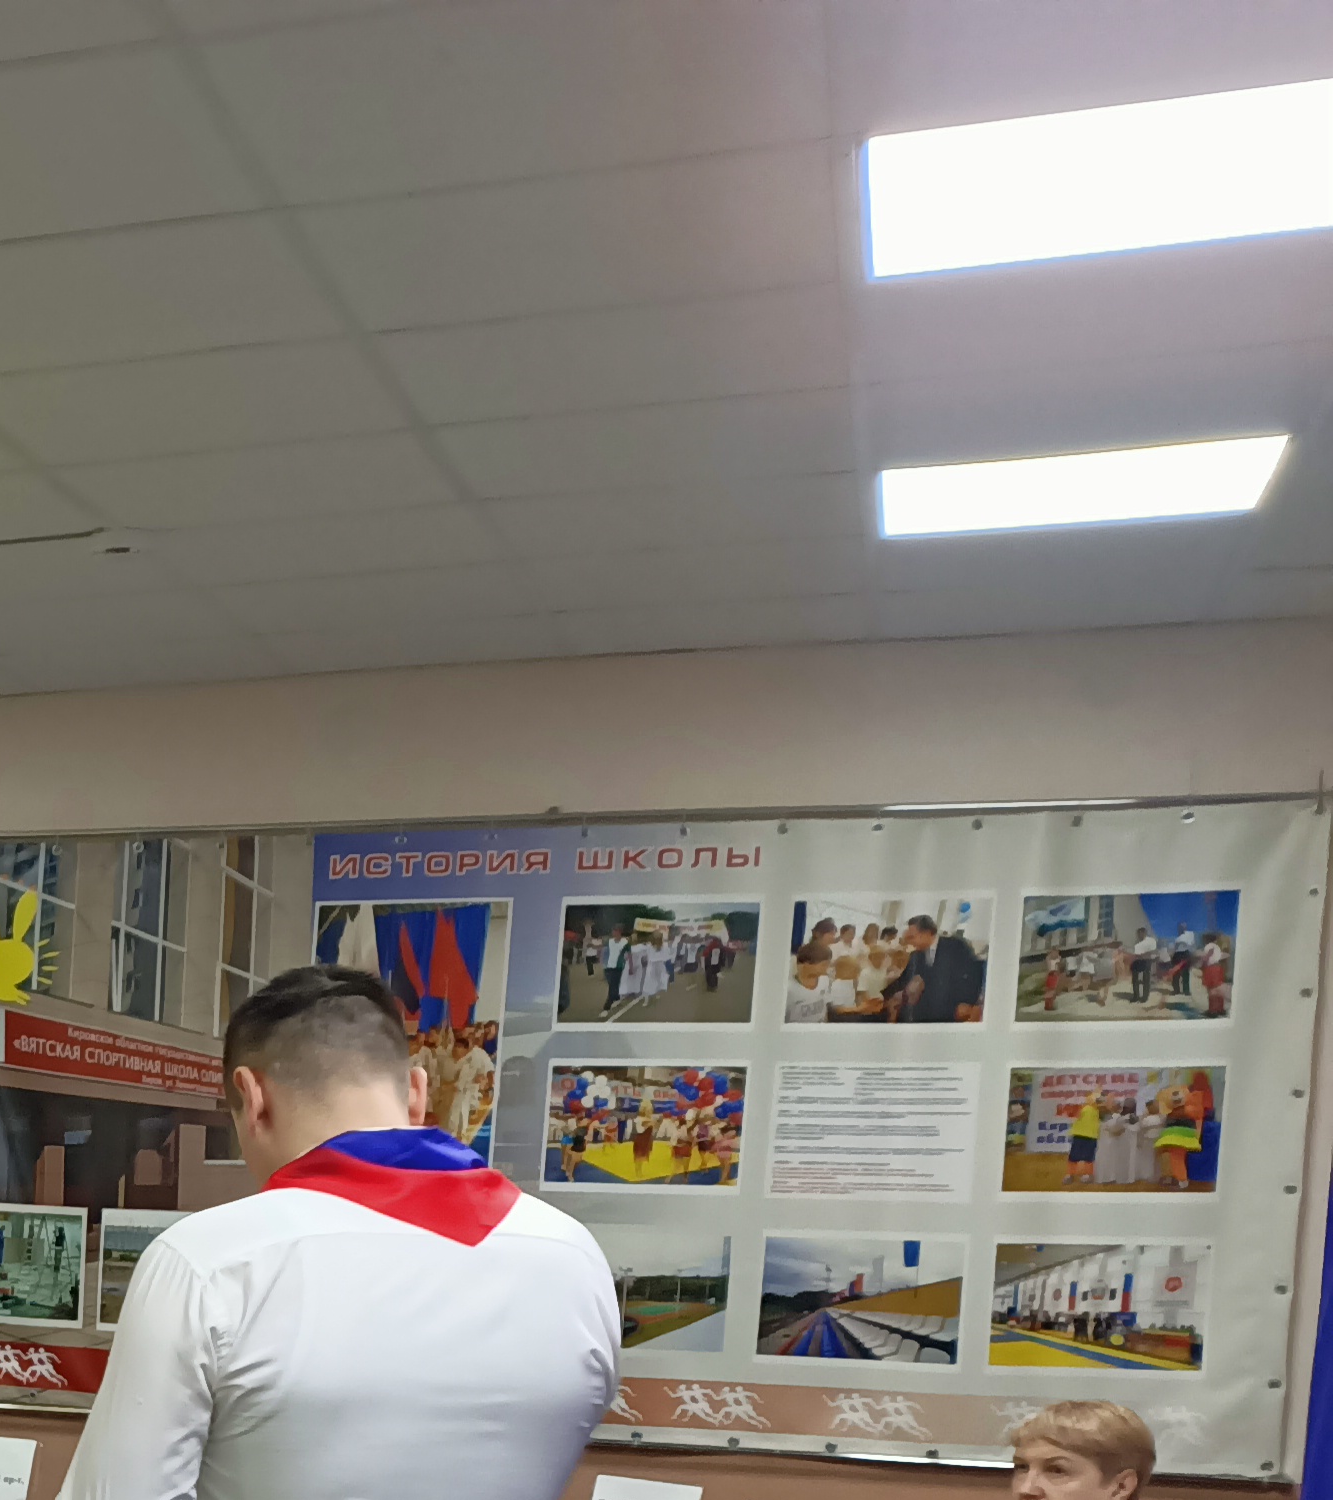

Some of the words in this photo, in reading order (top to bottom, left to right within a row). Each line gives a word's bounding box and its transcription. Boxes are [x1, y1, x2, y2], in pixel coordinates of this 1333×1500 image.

[329, 848, 551, 880] ИСТОРИЯ
[575, 846, 761, 872] ШКОЛЫ
[13, 1034, 81, 1061] «ВЯТСКАЯ
[85, 1047, 161, 1074] СПОРТИВНАЯ
[164, 1061, 200, 1080] ШКОЛА
